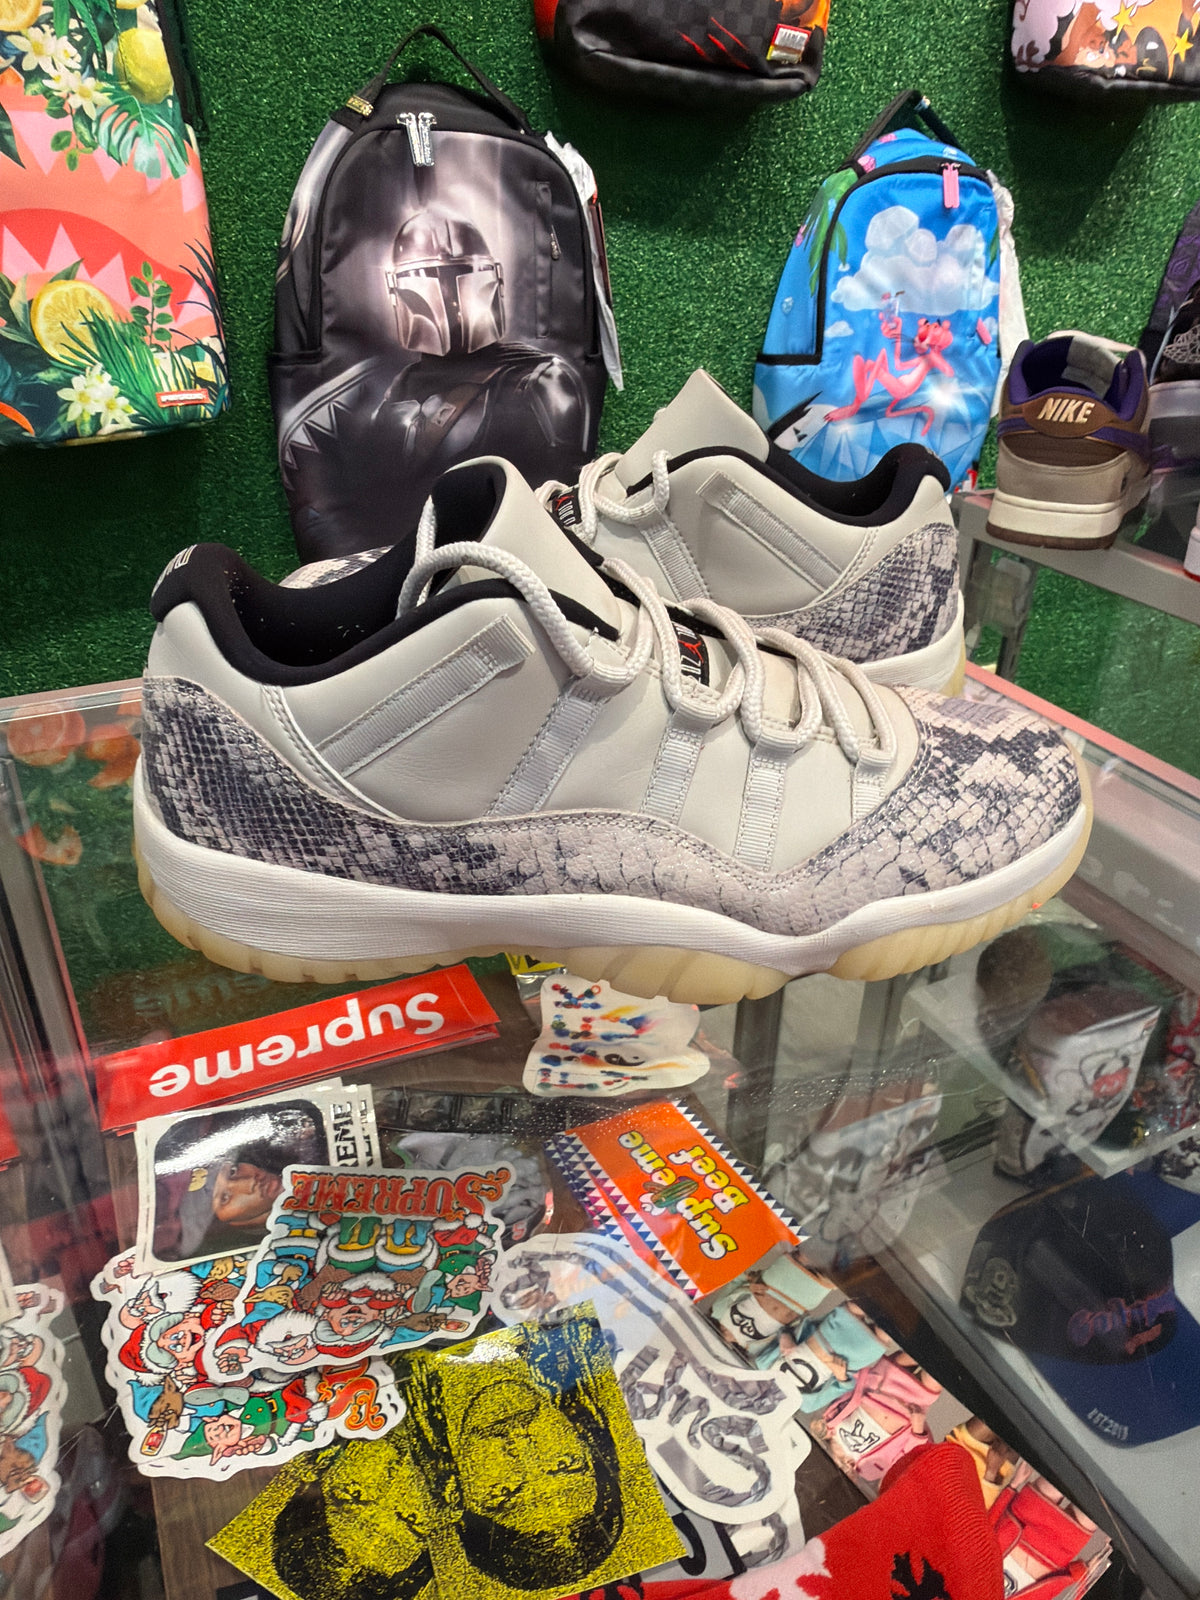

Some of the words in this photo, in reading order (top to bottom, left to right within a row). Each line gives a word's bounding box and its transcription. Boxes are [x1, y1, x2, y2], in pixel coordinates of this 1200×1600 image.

[1037, 397, 1095, 423] NIKE
[148, 991, 445, 1099] Supreme
[281, 1167, 512, 1222] SUPREME
[617, 1130, 738, 1261] Supeme
[667, 1144, 751, 1215] Beef
